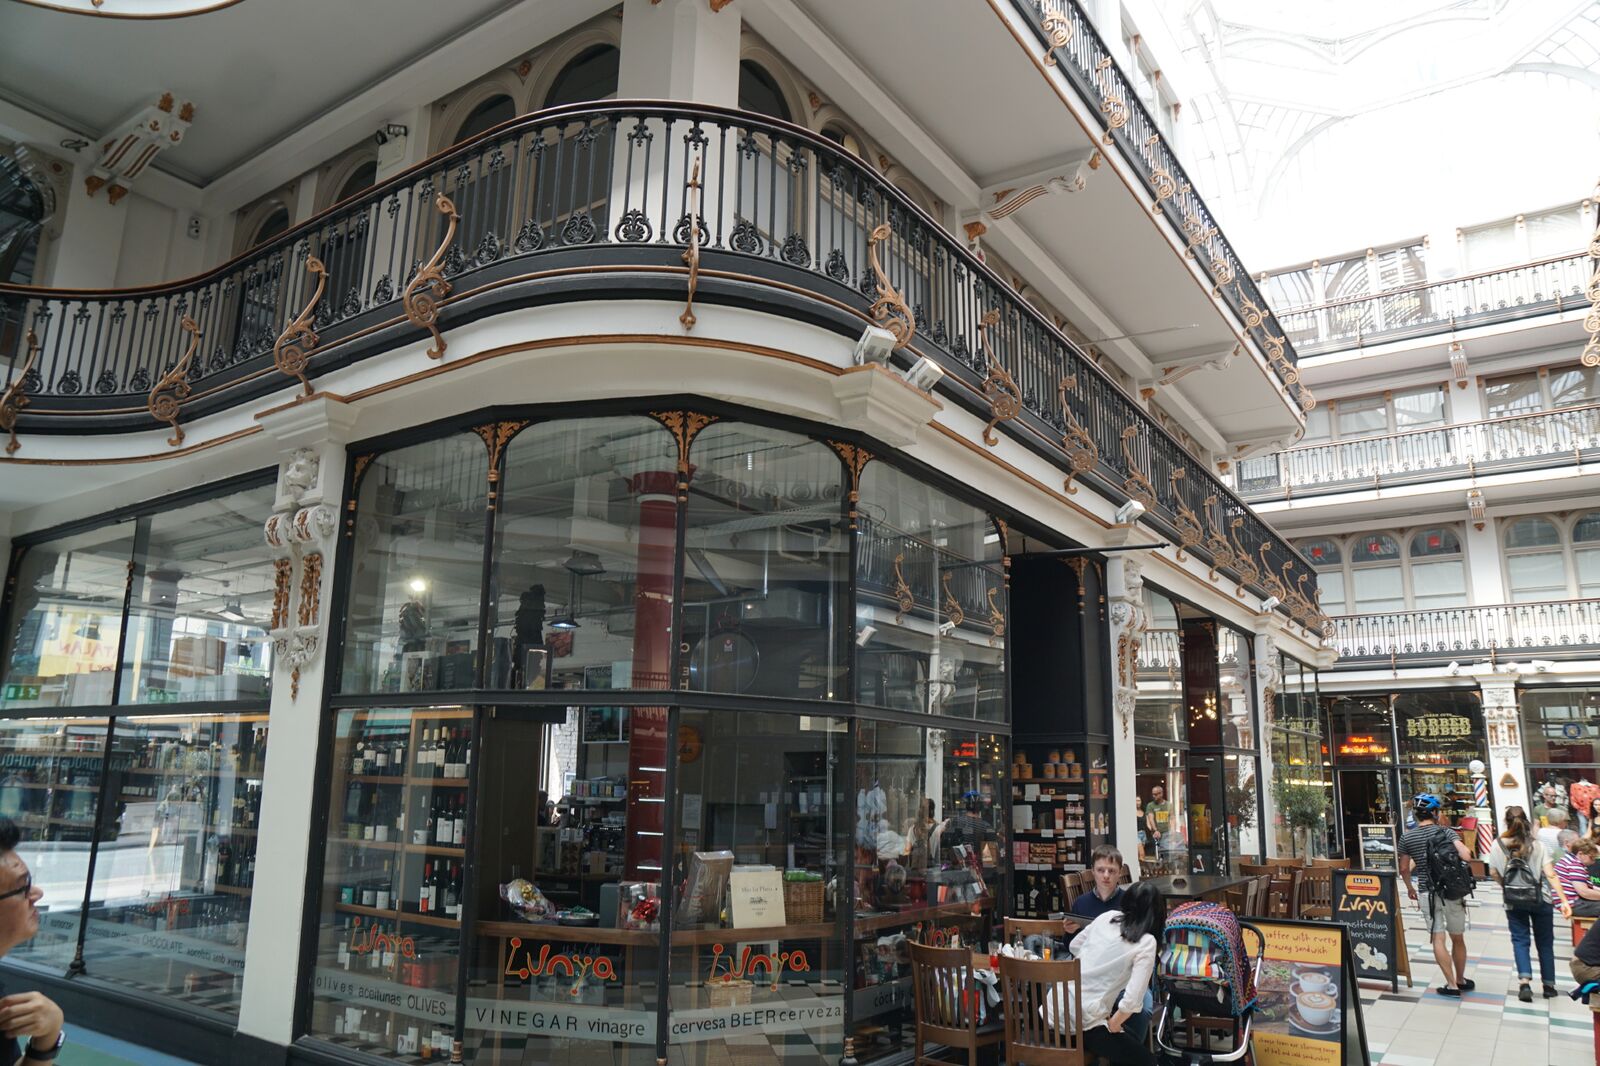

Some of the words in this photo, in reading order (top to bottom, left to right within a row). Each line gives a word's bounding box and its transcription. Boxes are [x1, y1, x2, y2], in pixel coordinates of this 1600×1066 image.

[1406, 717, 1470, 728] BARBER
[1338, 894, 1388, 919] Lunya
[141, 934, 183, 953] CHOCOLATE
[1266, 930, 1290, 940] coffee
[1292, 932, 1310, 942] with
[1313, 936, 1337, 947] every
[1295, 945, 1328, 954] sandwich
[505, 936, 617, 996] Lunya
[709, 943, 810, 992] Lunya
[316, 977, 355, 995] olives
[358, 985, 401, 1006] aceitunas
[407, 994, 447, 1016] OLIVES
[475, 1007, 578, 1031] VINEGAR
[588, 1018, 645, 1038] vinagre
[672, 1017, 727, 1035] cervesa
[730, 1009, 776, 1028] BEER
[779, 1005, 842, 1021] cerveza
